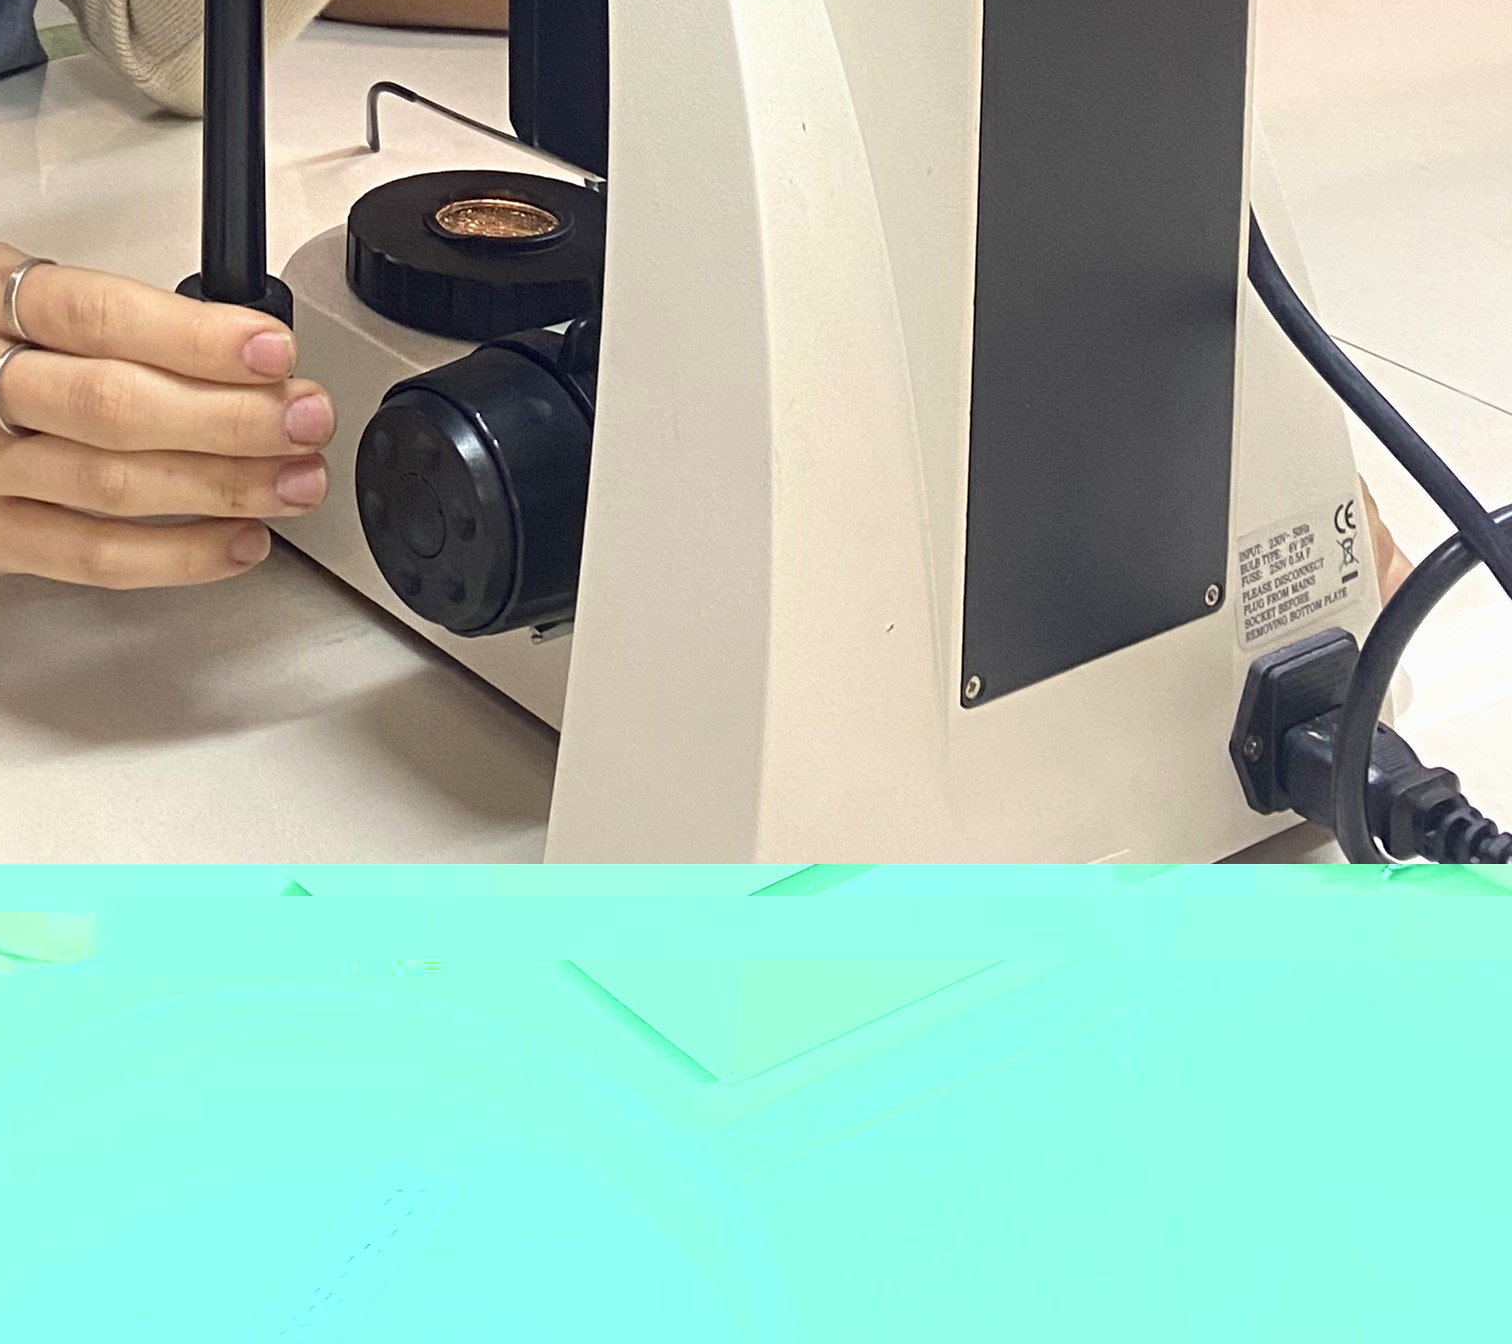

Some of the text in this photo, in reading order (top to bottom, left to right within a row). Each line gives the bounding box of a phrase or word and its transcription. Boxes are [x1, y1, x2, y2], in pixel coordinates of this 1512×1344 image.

[1334, 500, 1356, 534] CE
[1240, 558, 1260, 575] BULB
[1242, 557, 1324, 603] PLEASE DISCONNECT
[1243, 574, 1316, 616] PLUG FROM MAINS
[1244, 591, 1310, 629] SOCKET BEFORE
[1245, 586, 1347, 643] REMOVING BOTTOM PLATE
